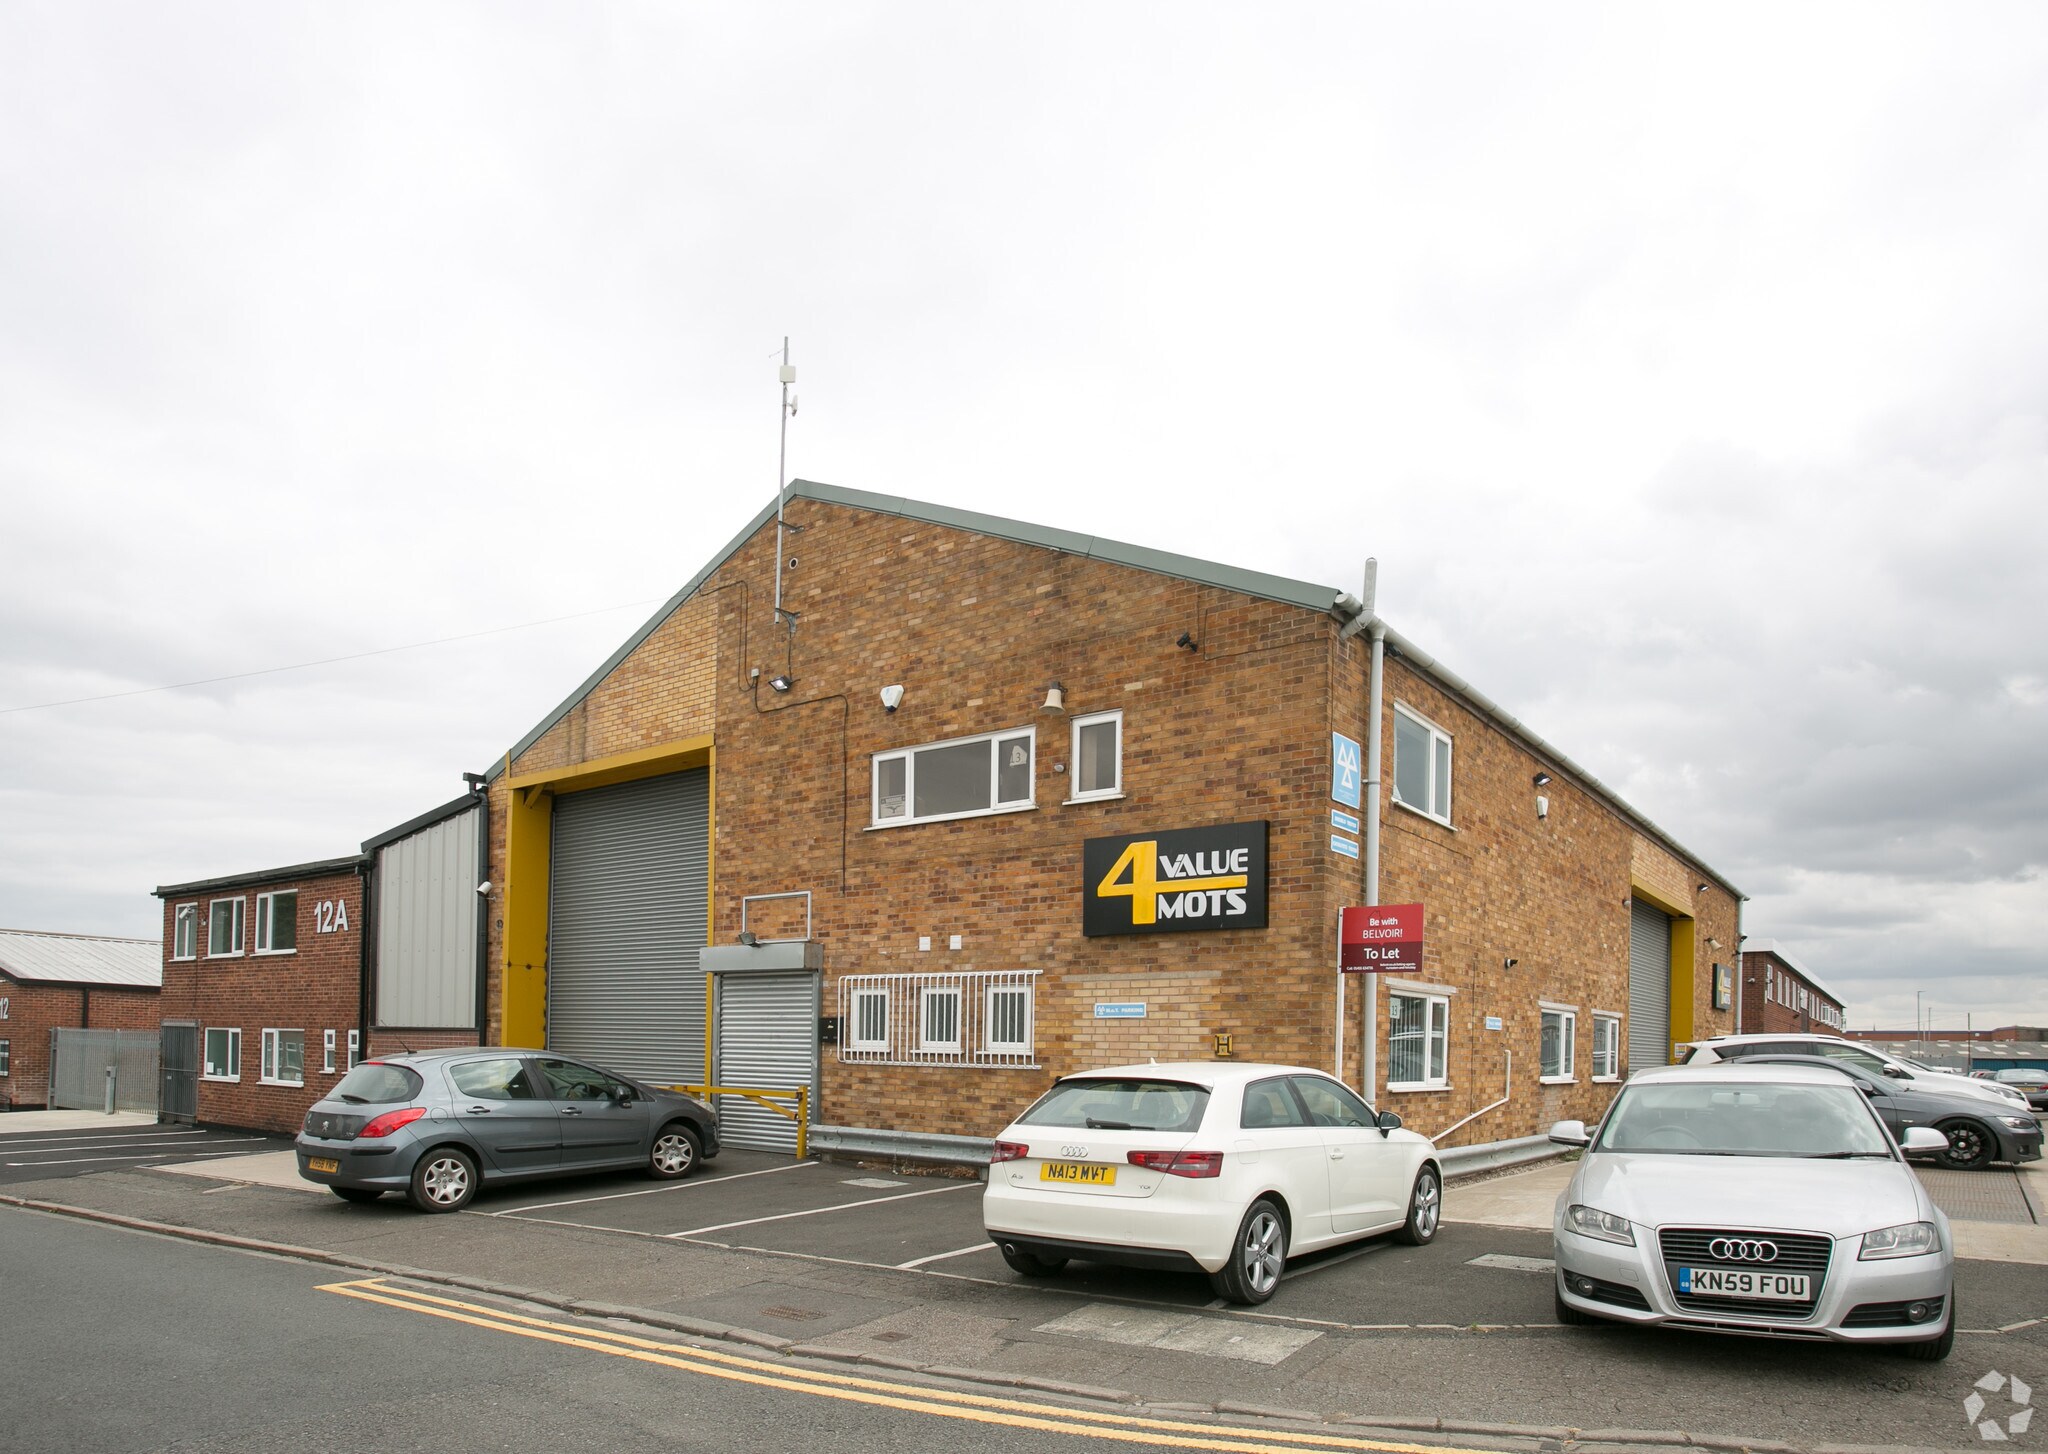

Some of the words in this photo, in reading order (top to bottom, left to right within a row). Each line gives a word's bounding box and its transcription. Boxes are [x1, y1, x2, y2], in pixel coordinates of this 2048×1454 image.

[1159, 848, 1248, 878] VALUE
[1098, 840, 1247, 924] 4
[1158, 888, 1247, 919] MOTS
[313, 899, 349, 934] 12A
[1369, 917, 1380, 927] Be
[1381, 916, 1398, 926] with
[1362, 928, 1403, 939] BELVOIR!
[1363, 947, 1379, 960] To
[1381, 947, 1400, 959] Let
[1048, 1164, 1077, 1179] NA13
[1080, 1166, 1108, 1181] MVT
[1694, 1271, 1752, 1292] KN59
[1760, 1275, 1804, 1295] FOU
